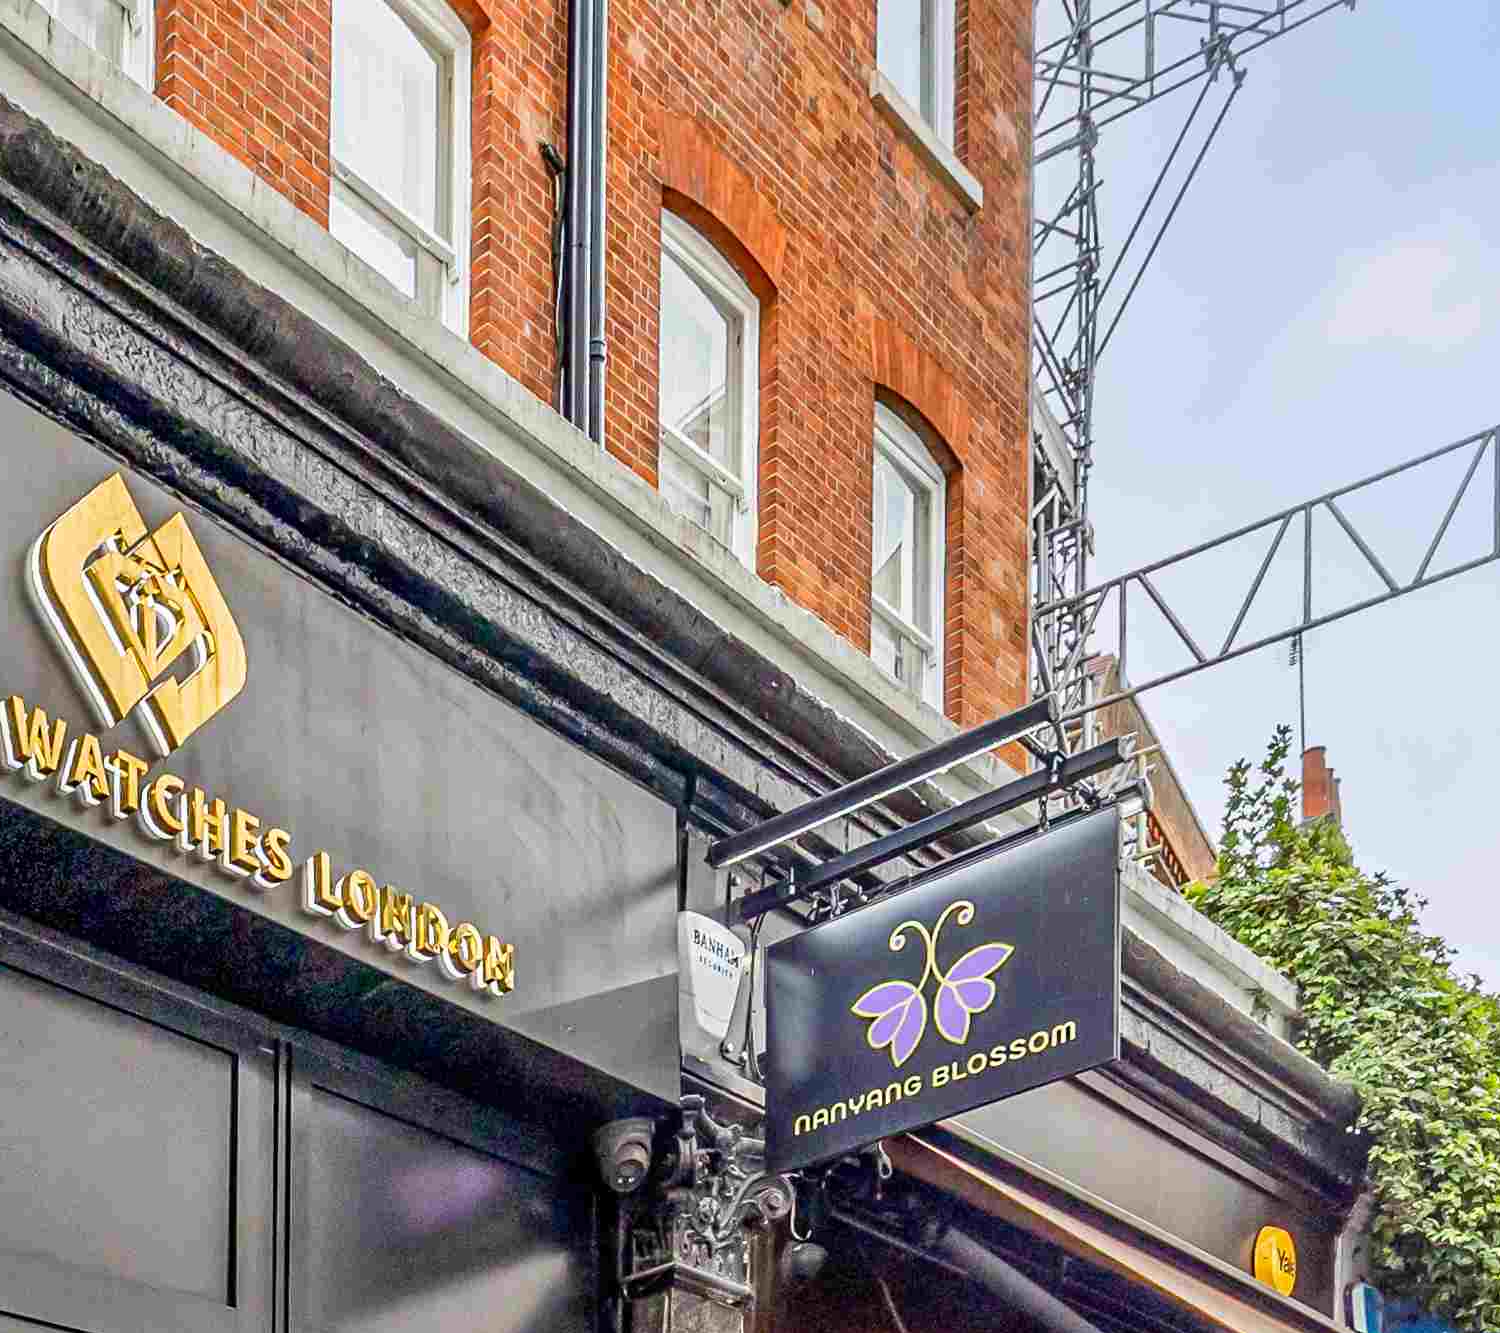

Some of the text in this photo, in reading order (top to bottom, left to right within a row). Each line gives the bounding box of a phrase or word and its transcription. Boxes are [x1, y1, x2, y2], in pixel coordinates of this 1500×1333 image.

[304, 850, 516, 997] LONDON
[793, 1021, 1077, 1136] NANYANG BLOSSOM
